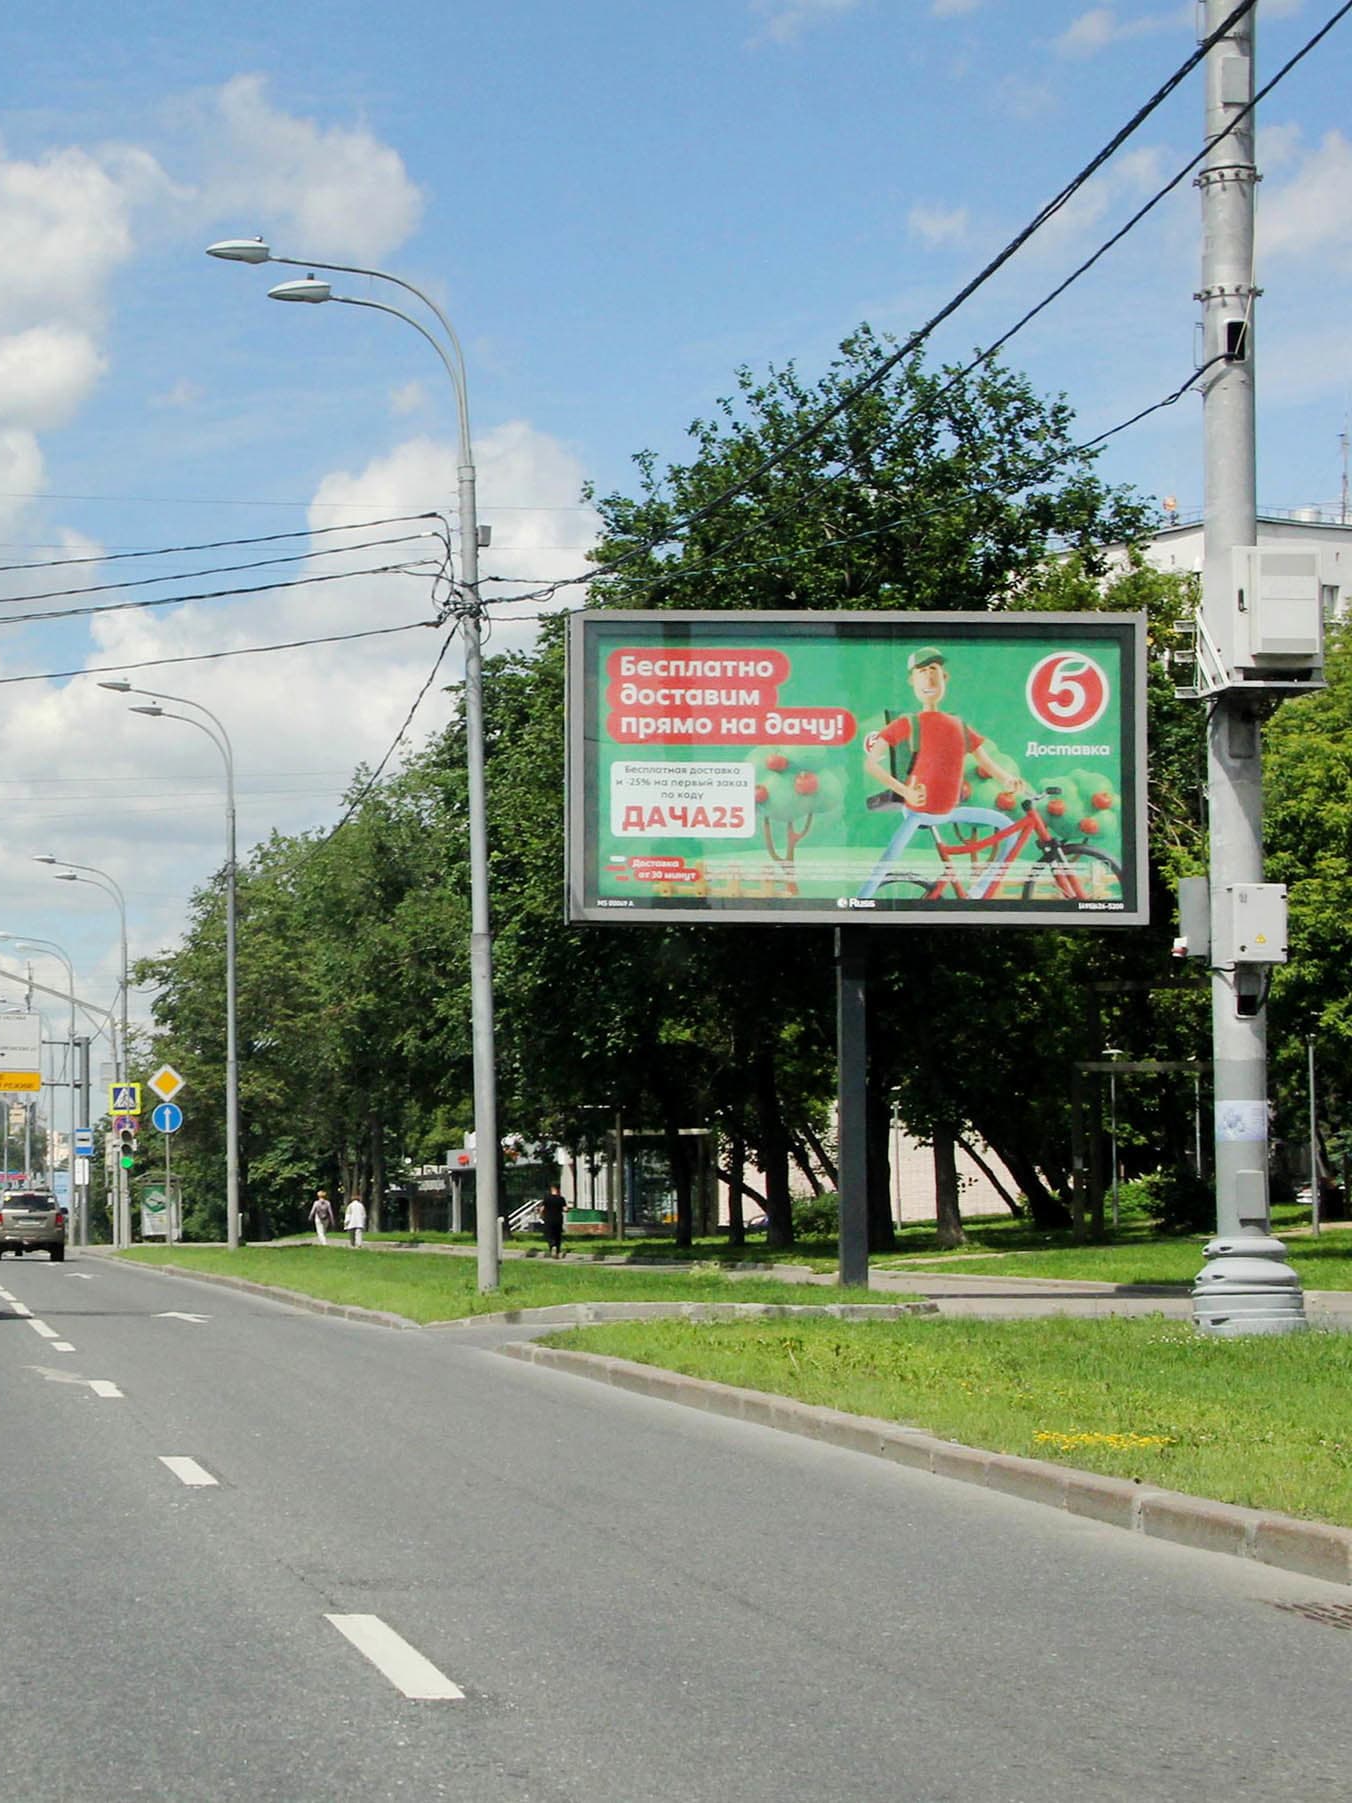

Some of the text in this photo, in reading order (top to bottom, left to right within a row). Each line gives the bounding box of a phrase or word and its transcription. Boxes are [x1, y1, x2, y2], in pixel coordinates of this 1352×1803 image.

[620, 656, 774, 677] Бесплатно
[620, 683, 760, 706] доставим
[1047, 658, 1089, 718] 5
[620, 712, 844, 741] прямо на дачу!
[1025, 741, 1110, 758] Доставка
[624, 765, 741, 775] Бесплатная доставка
[653, 779, 668, 787] на
[671, 778, 713, 788] первый
[716, 779, 748, 788] заказ
[661, 791, 704, 800] по коду
[622, 805, 745, 831] ДАЧА25
